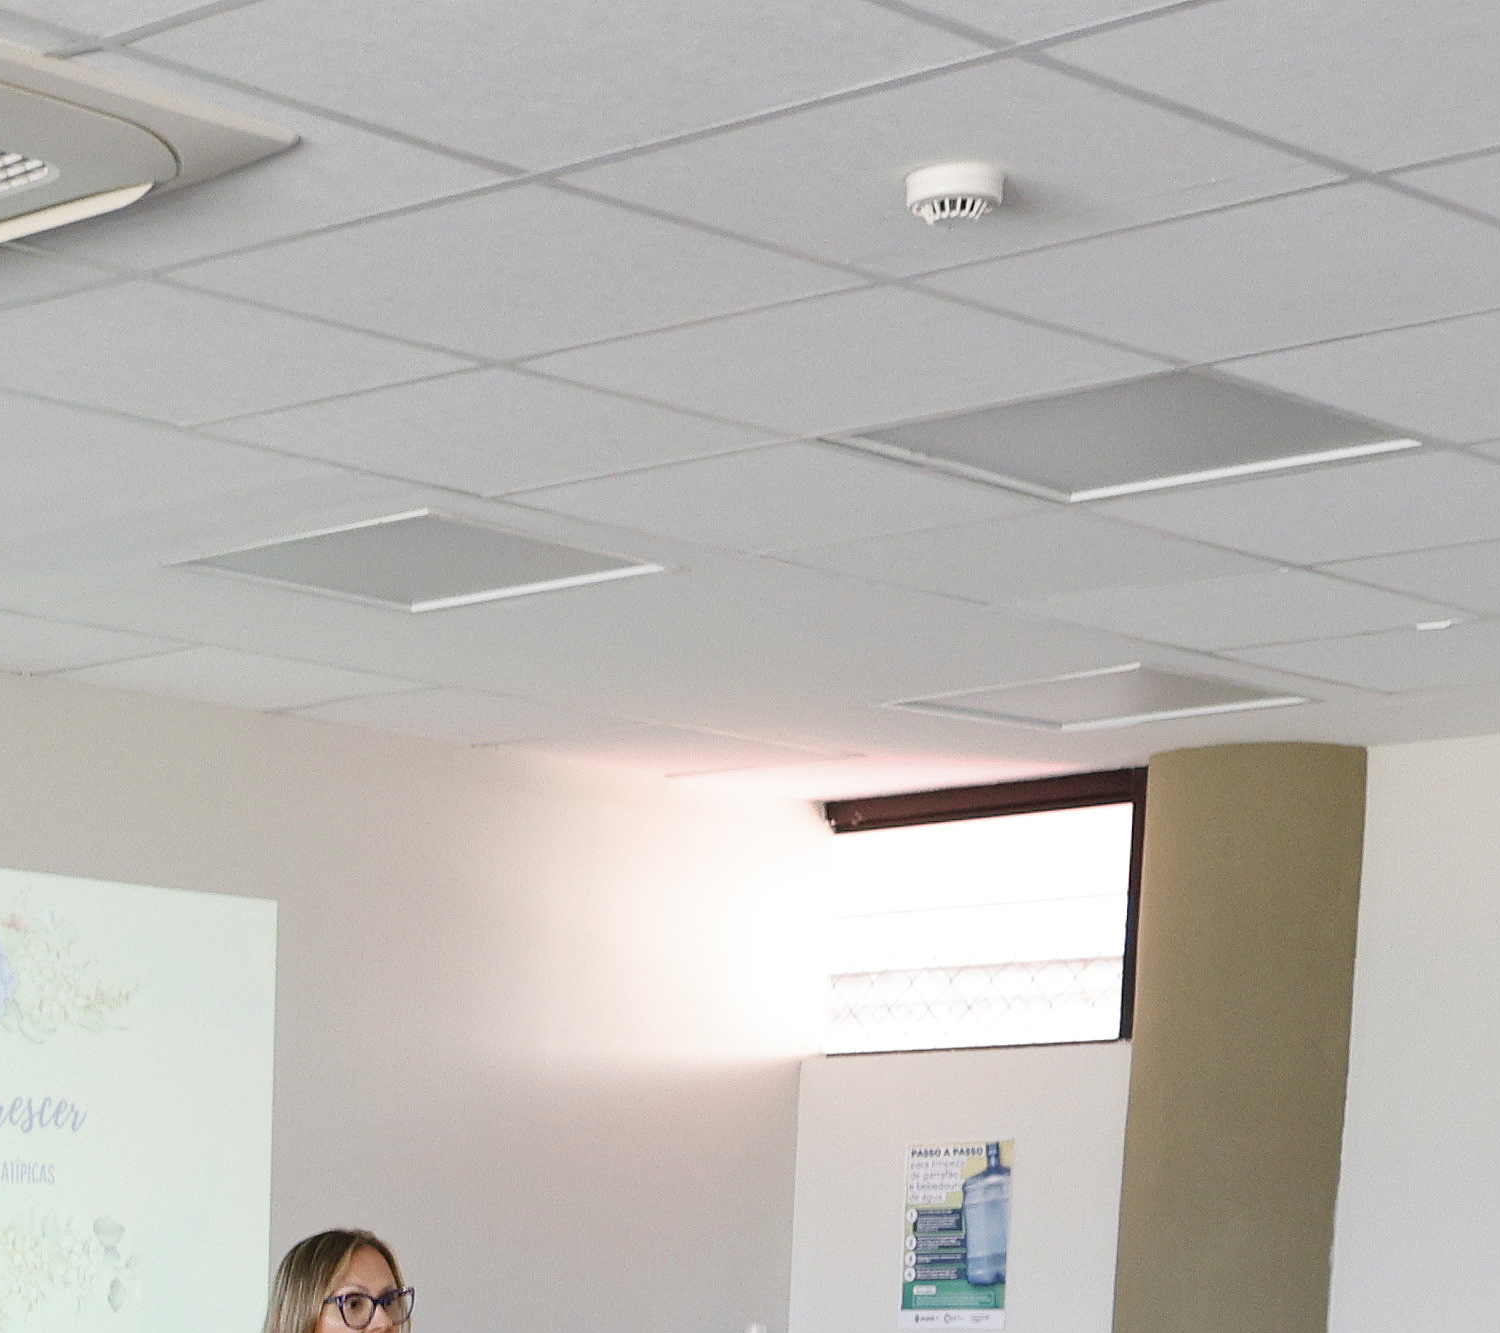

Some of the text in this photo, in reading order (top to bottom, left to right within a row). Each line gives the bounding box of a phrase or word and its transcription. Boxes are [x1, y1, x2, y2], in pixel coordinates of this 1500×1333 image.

[911, 1147, 983, 1158] PASSO A PASSO
[0, 1156, 56, 1186] ATÍPICAS
